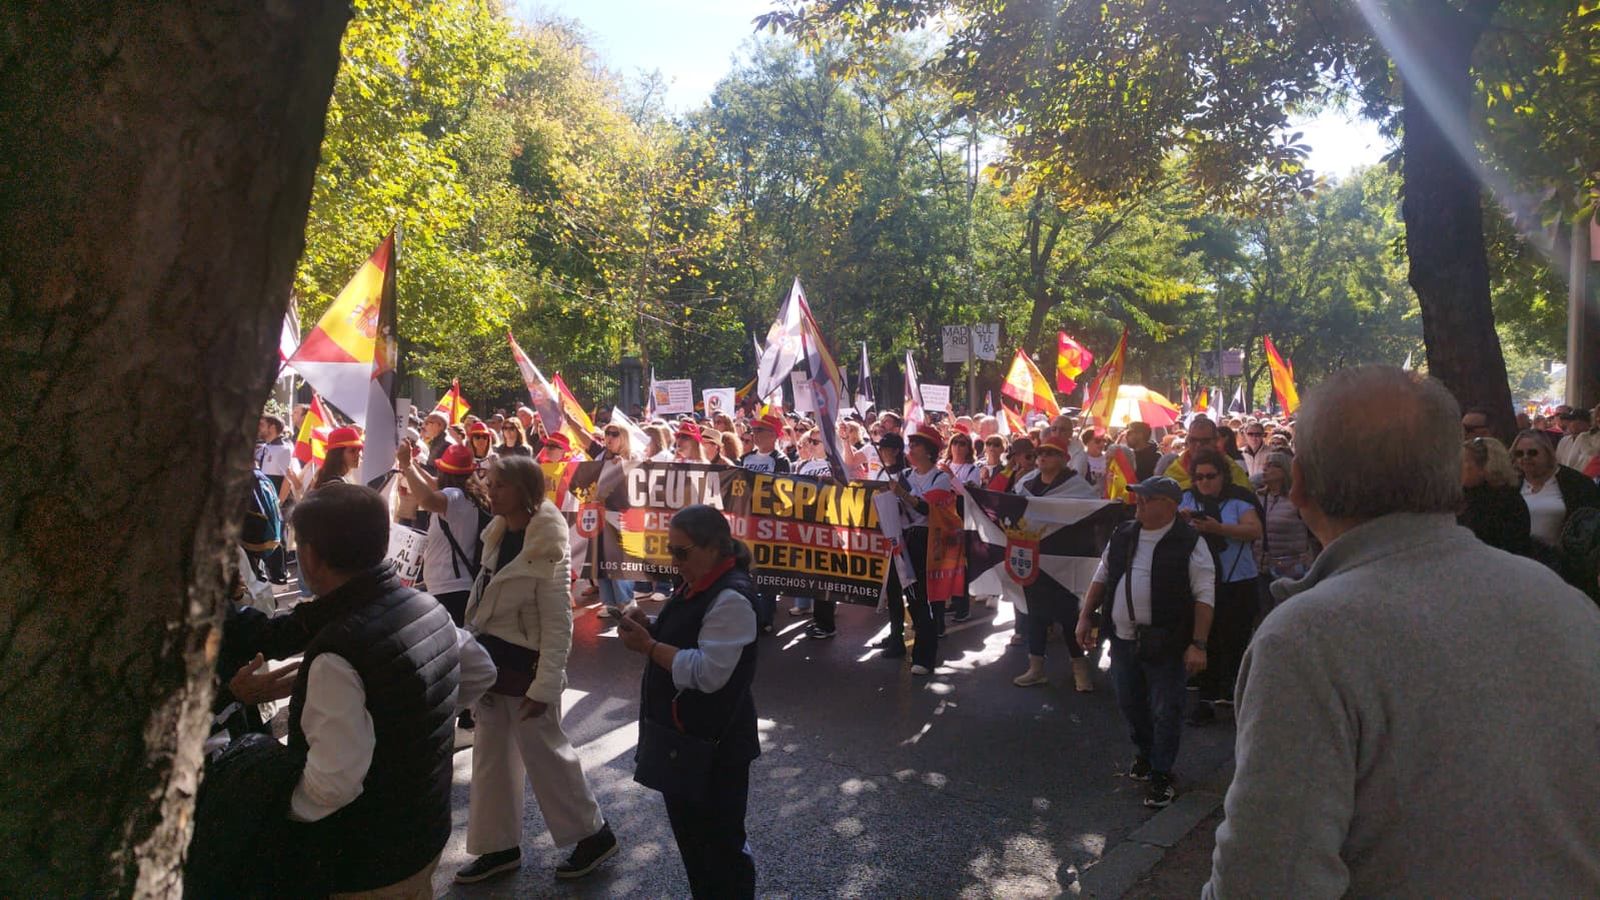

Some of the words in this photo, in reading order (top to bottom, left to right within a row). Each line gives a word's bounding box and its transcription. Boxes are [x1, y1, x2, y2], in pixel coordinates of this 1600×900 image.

[628, 468, 724, 510] CEUTA
[757, 519, 789, 540] SE
[754, 543, 884, 579] DEFIENDE
[600, 561, 618, 570] LOS
[757, 574, 807, 589] DERECHOS
[809, 580, 815, 589] Y
[818, 581, 879, 598] LIBERTADES
